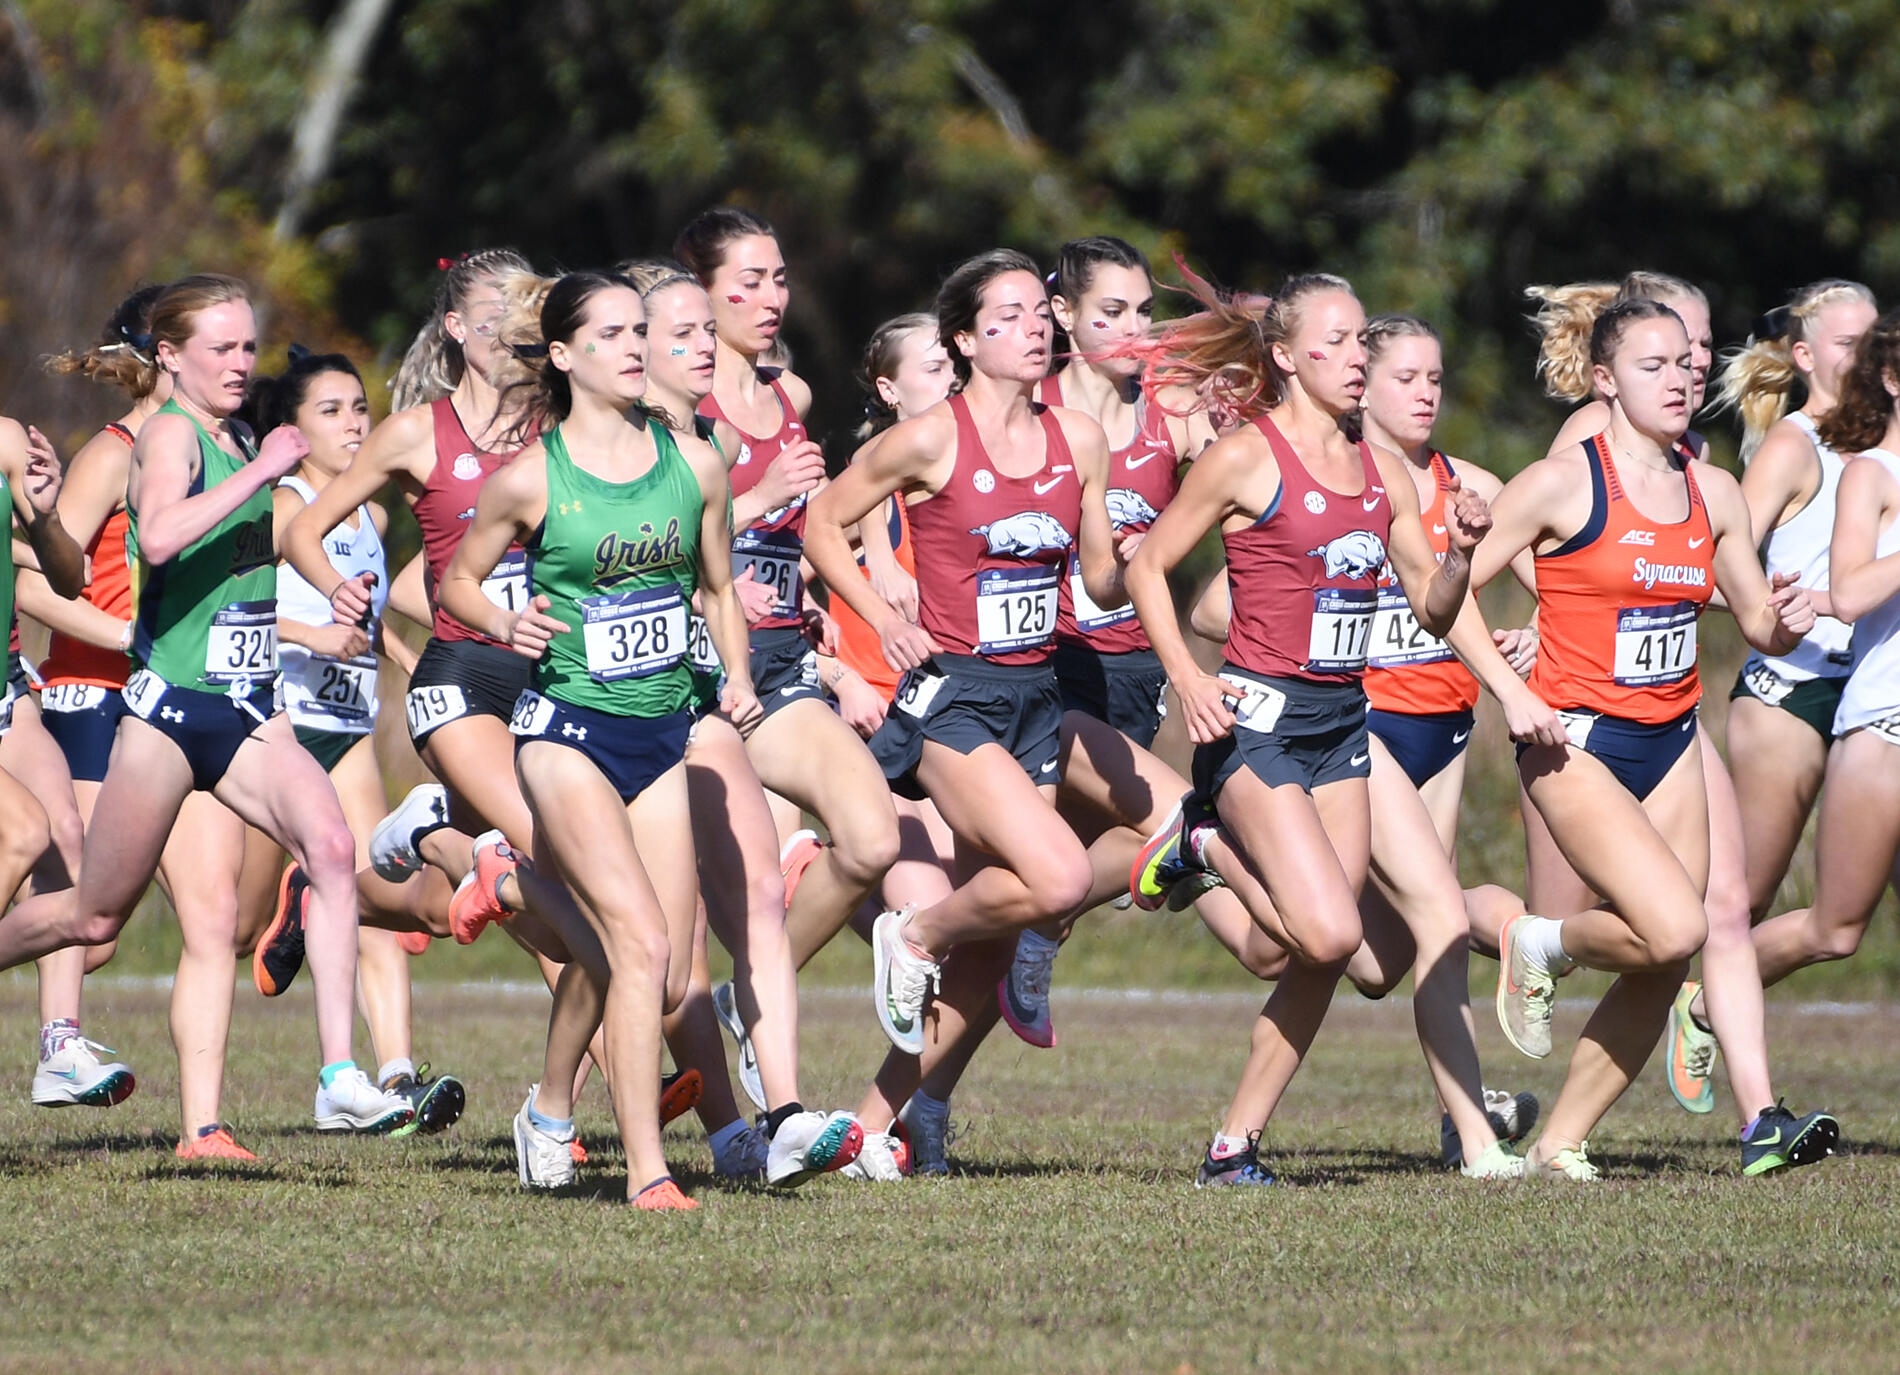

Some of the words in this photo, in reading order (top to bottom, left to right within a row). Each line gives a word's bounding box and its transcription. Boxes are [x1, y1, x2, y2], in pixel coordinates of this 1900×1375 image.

[593, 517, 685, 576] Irish
[1619, 529, 1656, 542] ACC
[1632, 556, 1706, 590] Syracuse
[1000, 594, 1047, 635] 125
[1386, 613, 1441, 650] 42
[228, 628, 273, 669] 324
[608, 615, 669, 663] 328
[1332, 617, 1370, 656] 117
[1635, 630, 1686, 672] 417
[48, 684, 89, 708] 418
[316, 665, 363, 705] 251
[409, 687, 448, 728] 119
